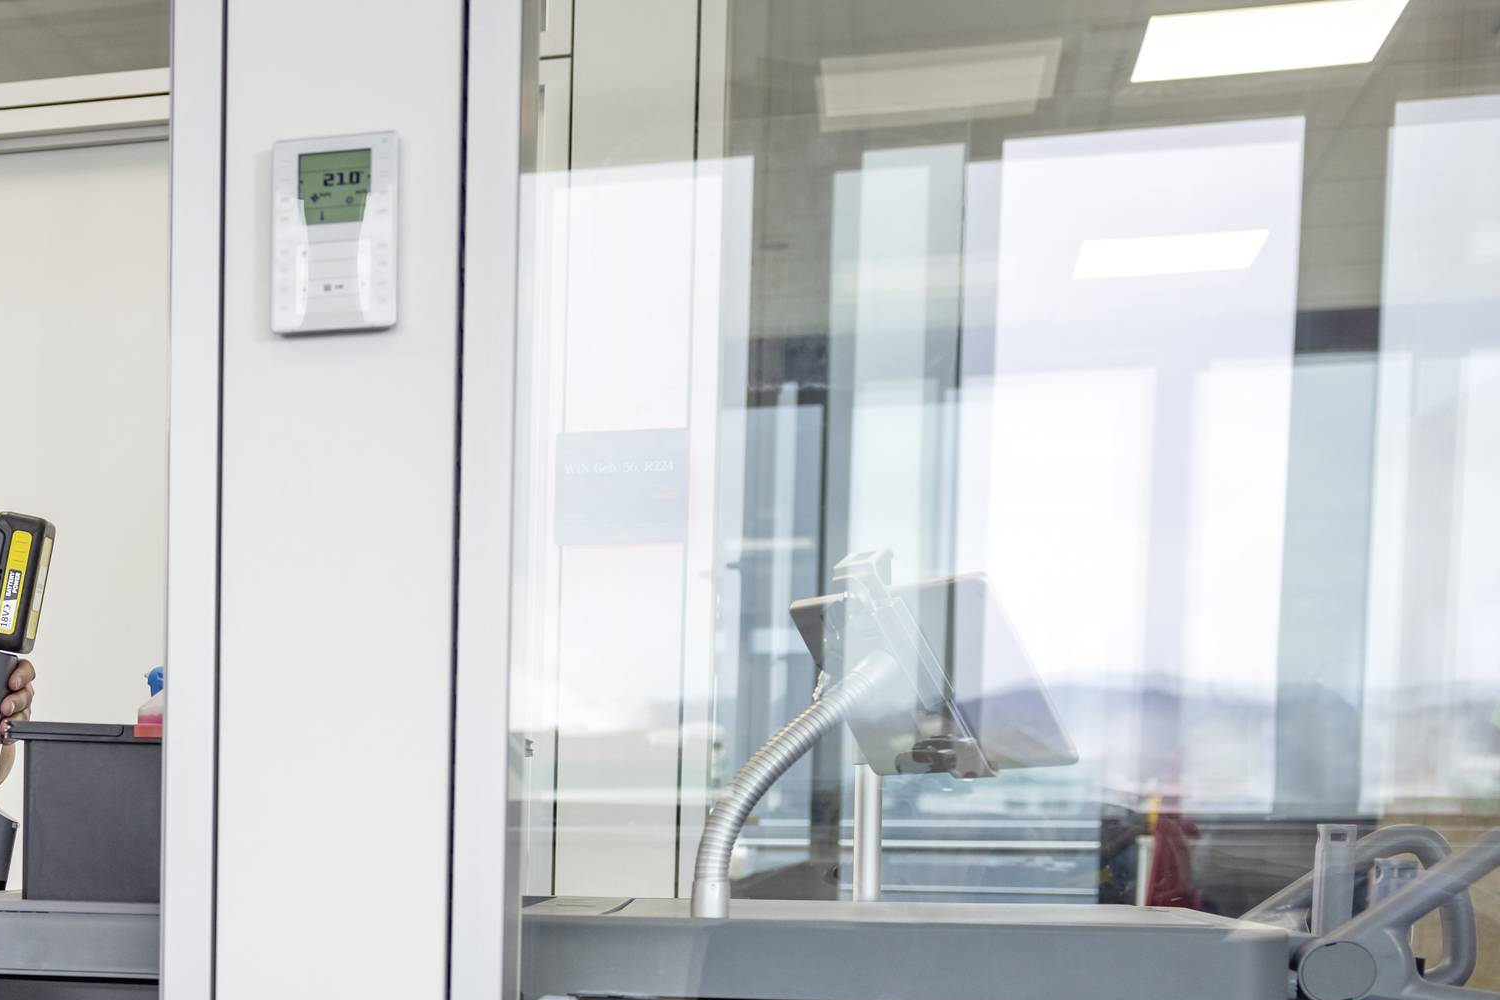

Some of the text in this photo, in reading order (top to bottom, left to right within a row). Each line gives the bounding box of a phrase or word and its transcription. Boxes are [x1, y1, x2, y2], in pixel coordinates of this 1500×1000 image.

[563, 463, 590, 474] WIN
[6, 571, 15, 597] BATTERY
[12, 572, 21, 594] POWER
